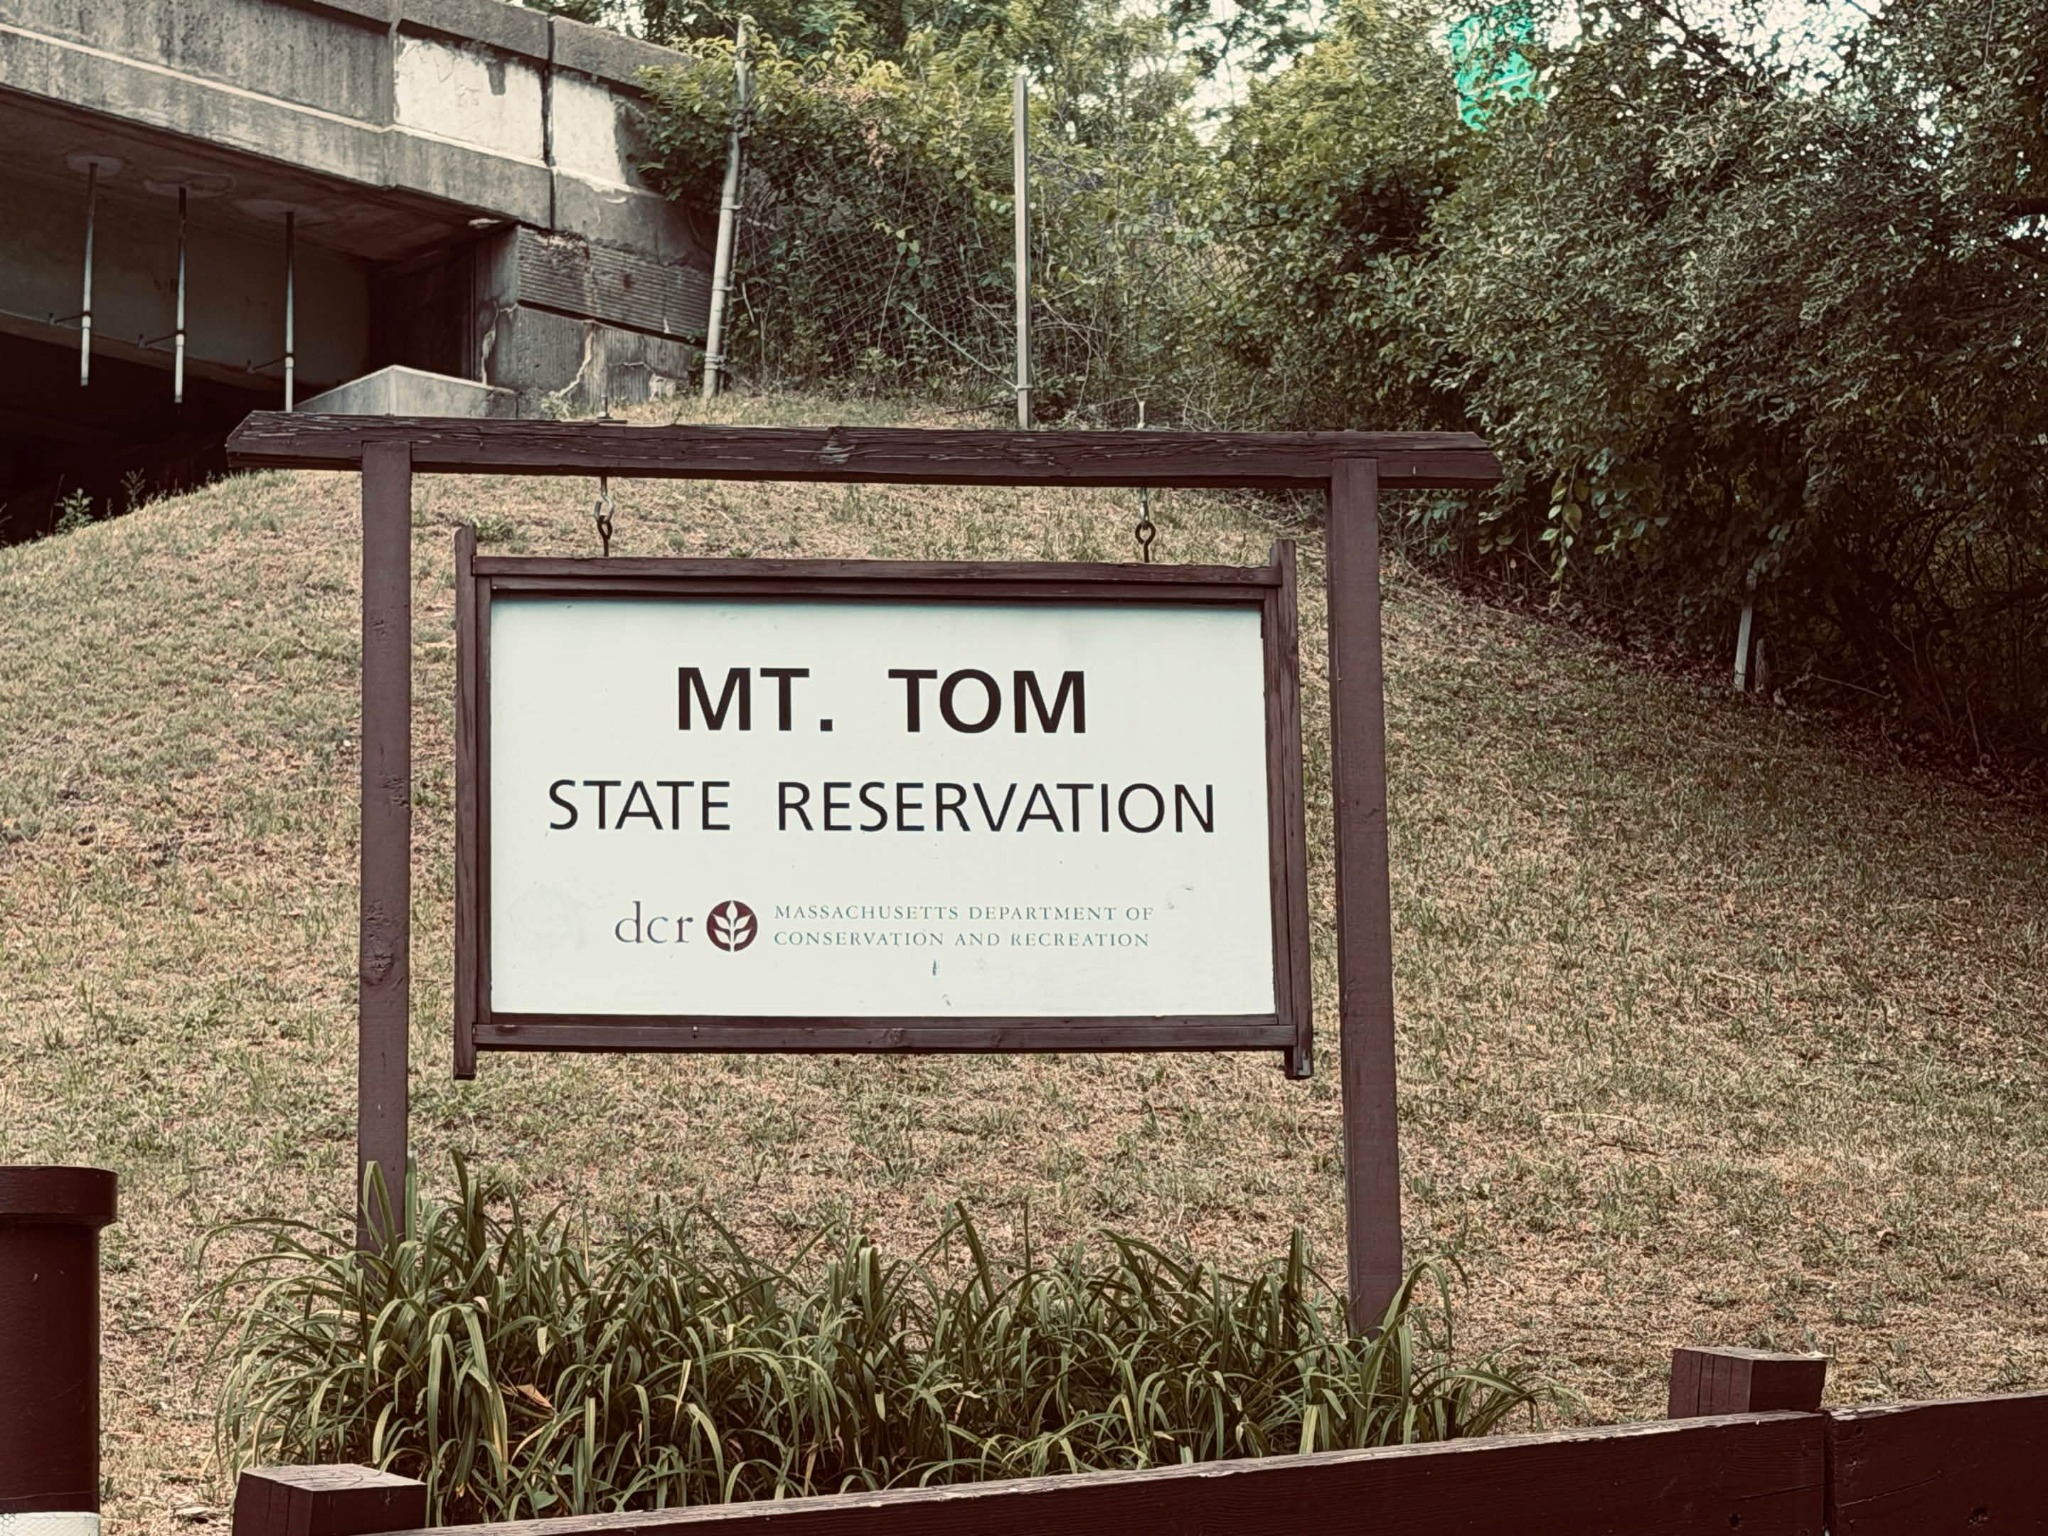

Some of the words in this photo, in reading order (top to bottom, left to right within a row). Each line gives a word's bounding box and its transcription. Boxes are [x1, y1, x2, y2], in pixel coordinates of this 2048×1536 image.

[677, 667, 833, 732] MT.
[888, 669, 1087, 735] TOM
[549, 779, 730, 830] STATE
[778, 781, 1215, 834] RESERVATION
[614, 900, 694, 944] dcr
[774, 904, 959, 921] MASSACHUSETTS
[968, 906, 1117, 921] DEPARTMENT
[1125, 906, 1154, 922] OF
[773, 931, 944, 947] CONSERVATION
[954, 932, 1000, 947] AND
[1010, 932, 1149, 947] RECREATION
